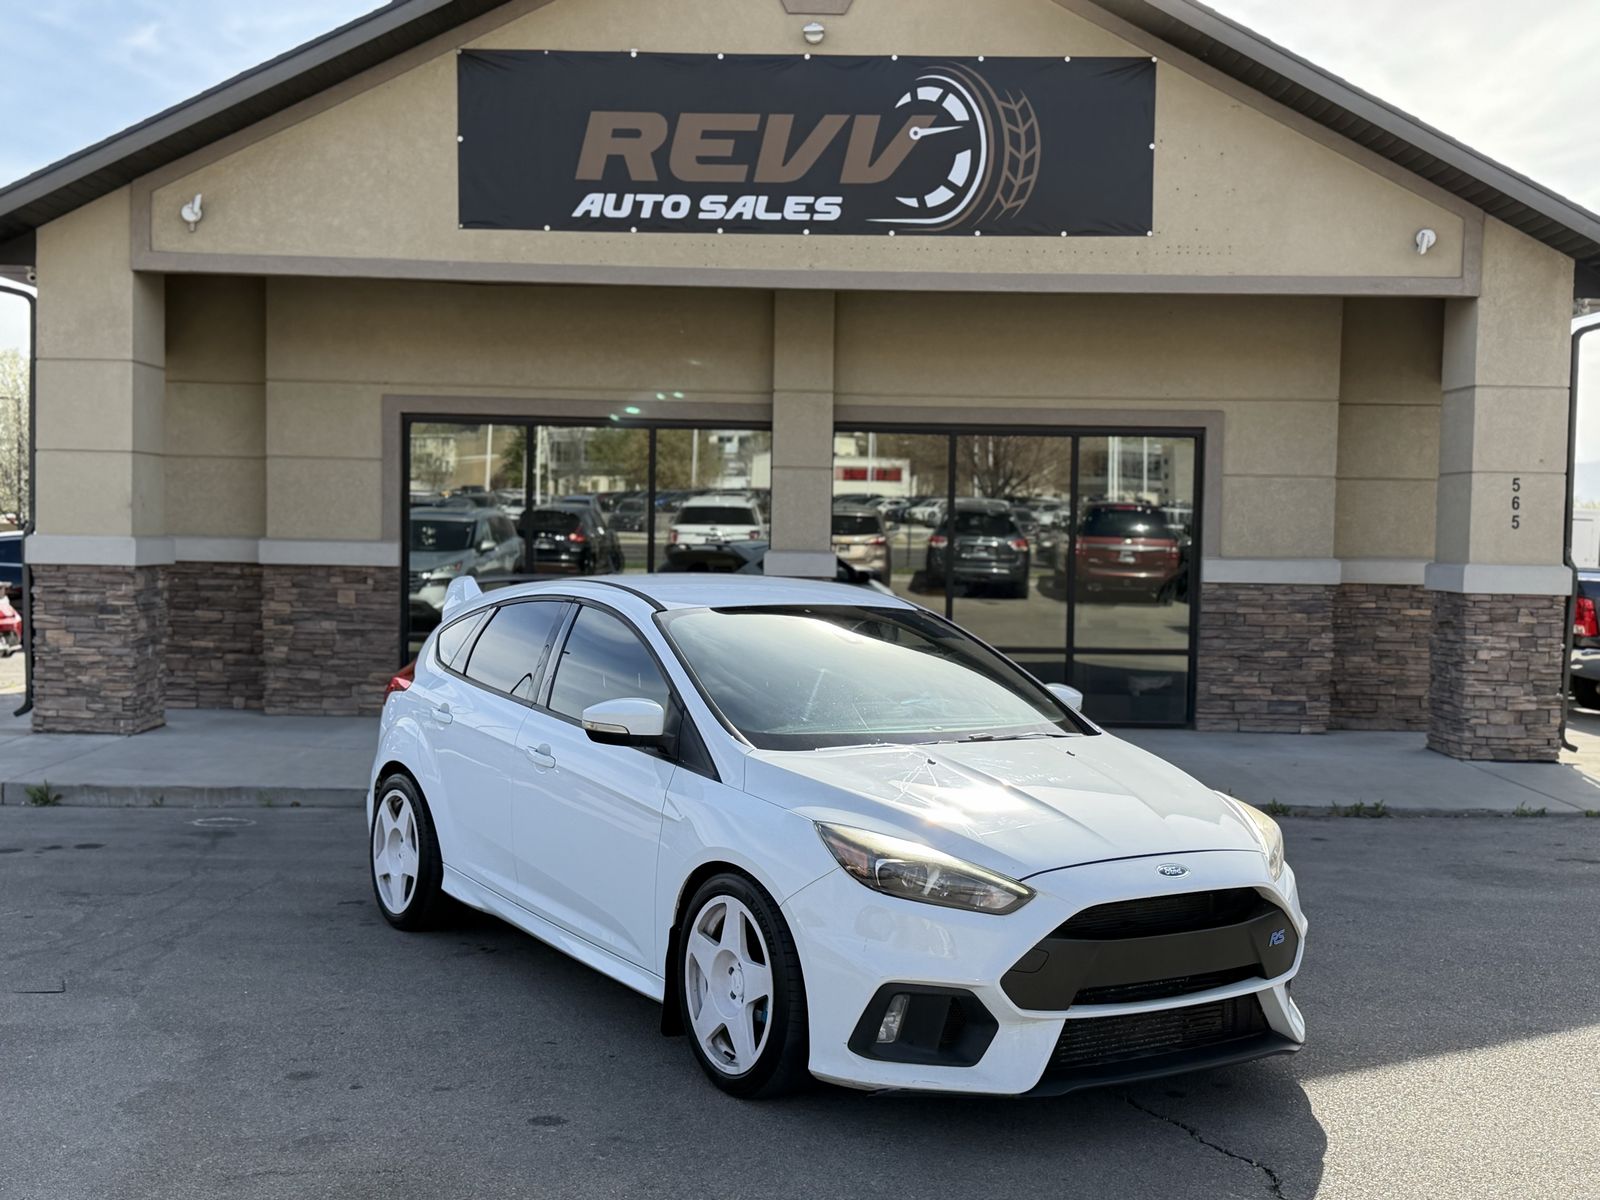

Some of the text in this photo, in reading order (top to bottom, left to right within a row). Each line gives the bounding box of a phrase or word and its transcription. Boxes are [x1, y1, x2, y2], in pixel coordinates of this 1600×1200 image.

[575, 111, 937, 183] REVV
[571, 193, 843, 221] AUTO SALES
[1511, 477, 1521, 530] 565
[1268, 928, 1286, 947] RS
